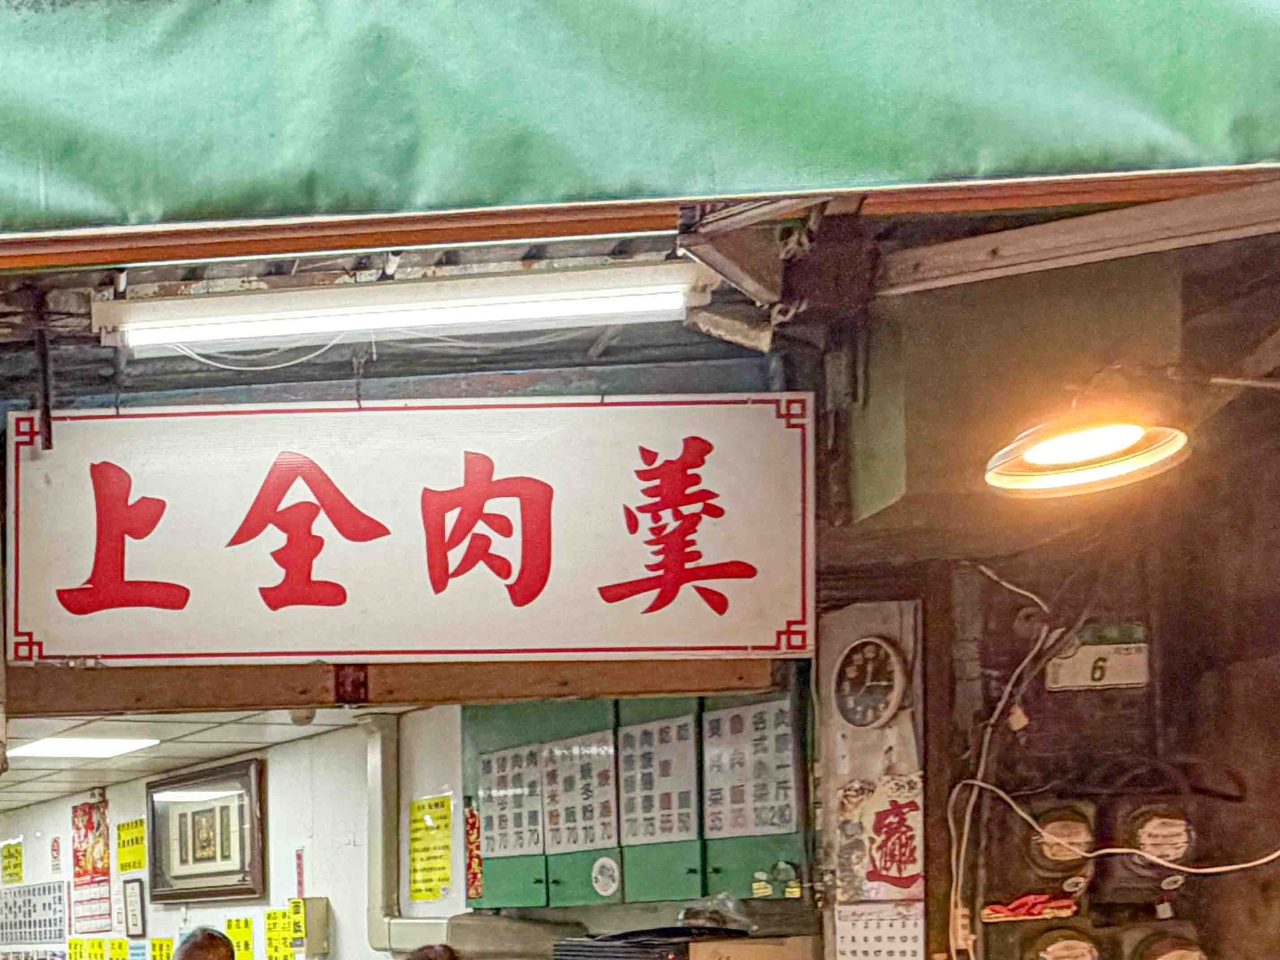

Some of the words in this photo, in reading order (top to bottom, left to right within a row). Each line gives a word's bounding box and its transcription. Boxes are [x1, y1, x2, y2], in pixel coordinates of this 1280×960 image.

[56, 436, 758, 616] 上全肉羹
[1091, 656, 1107, 682] 6
